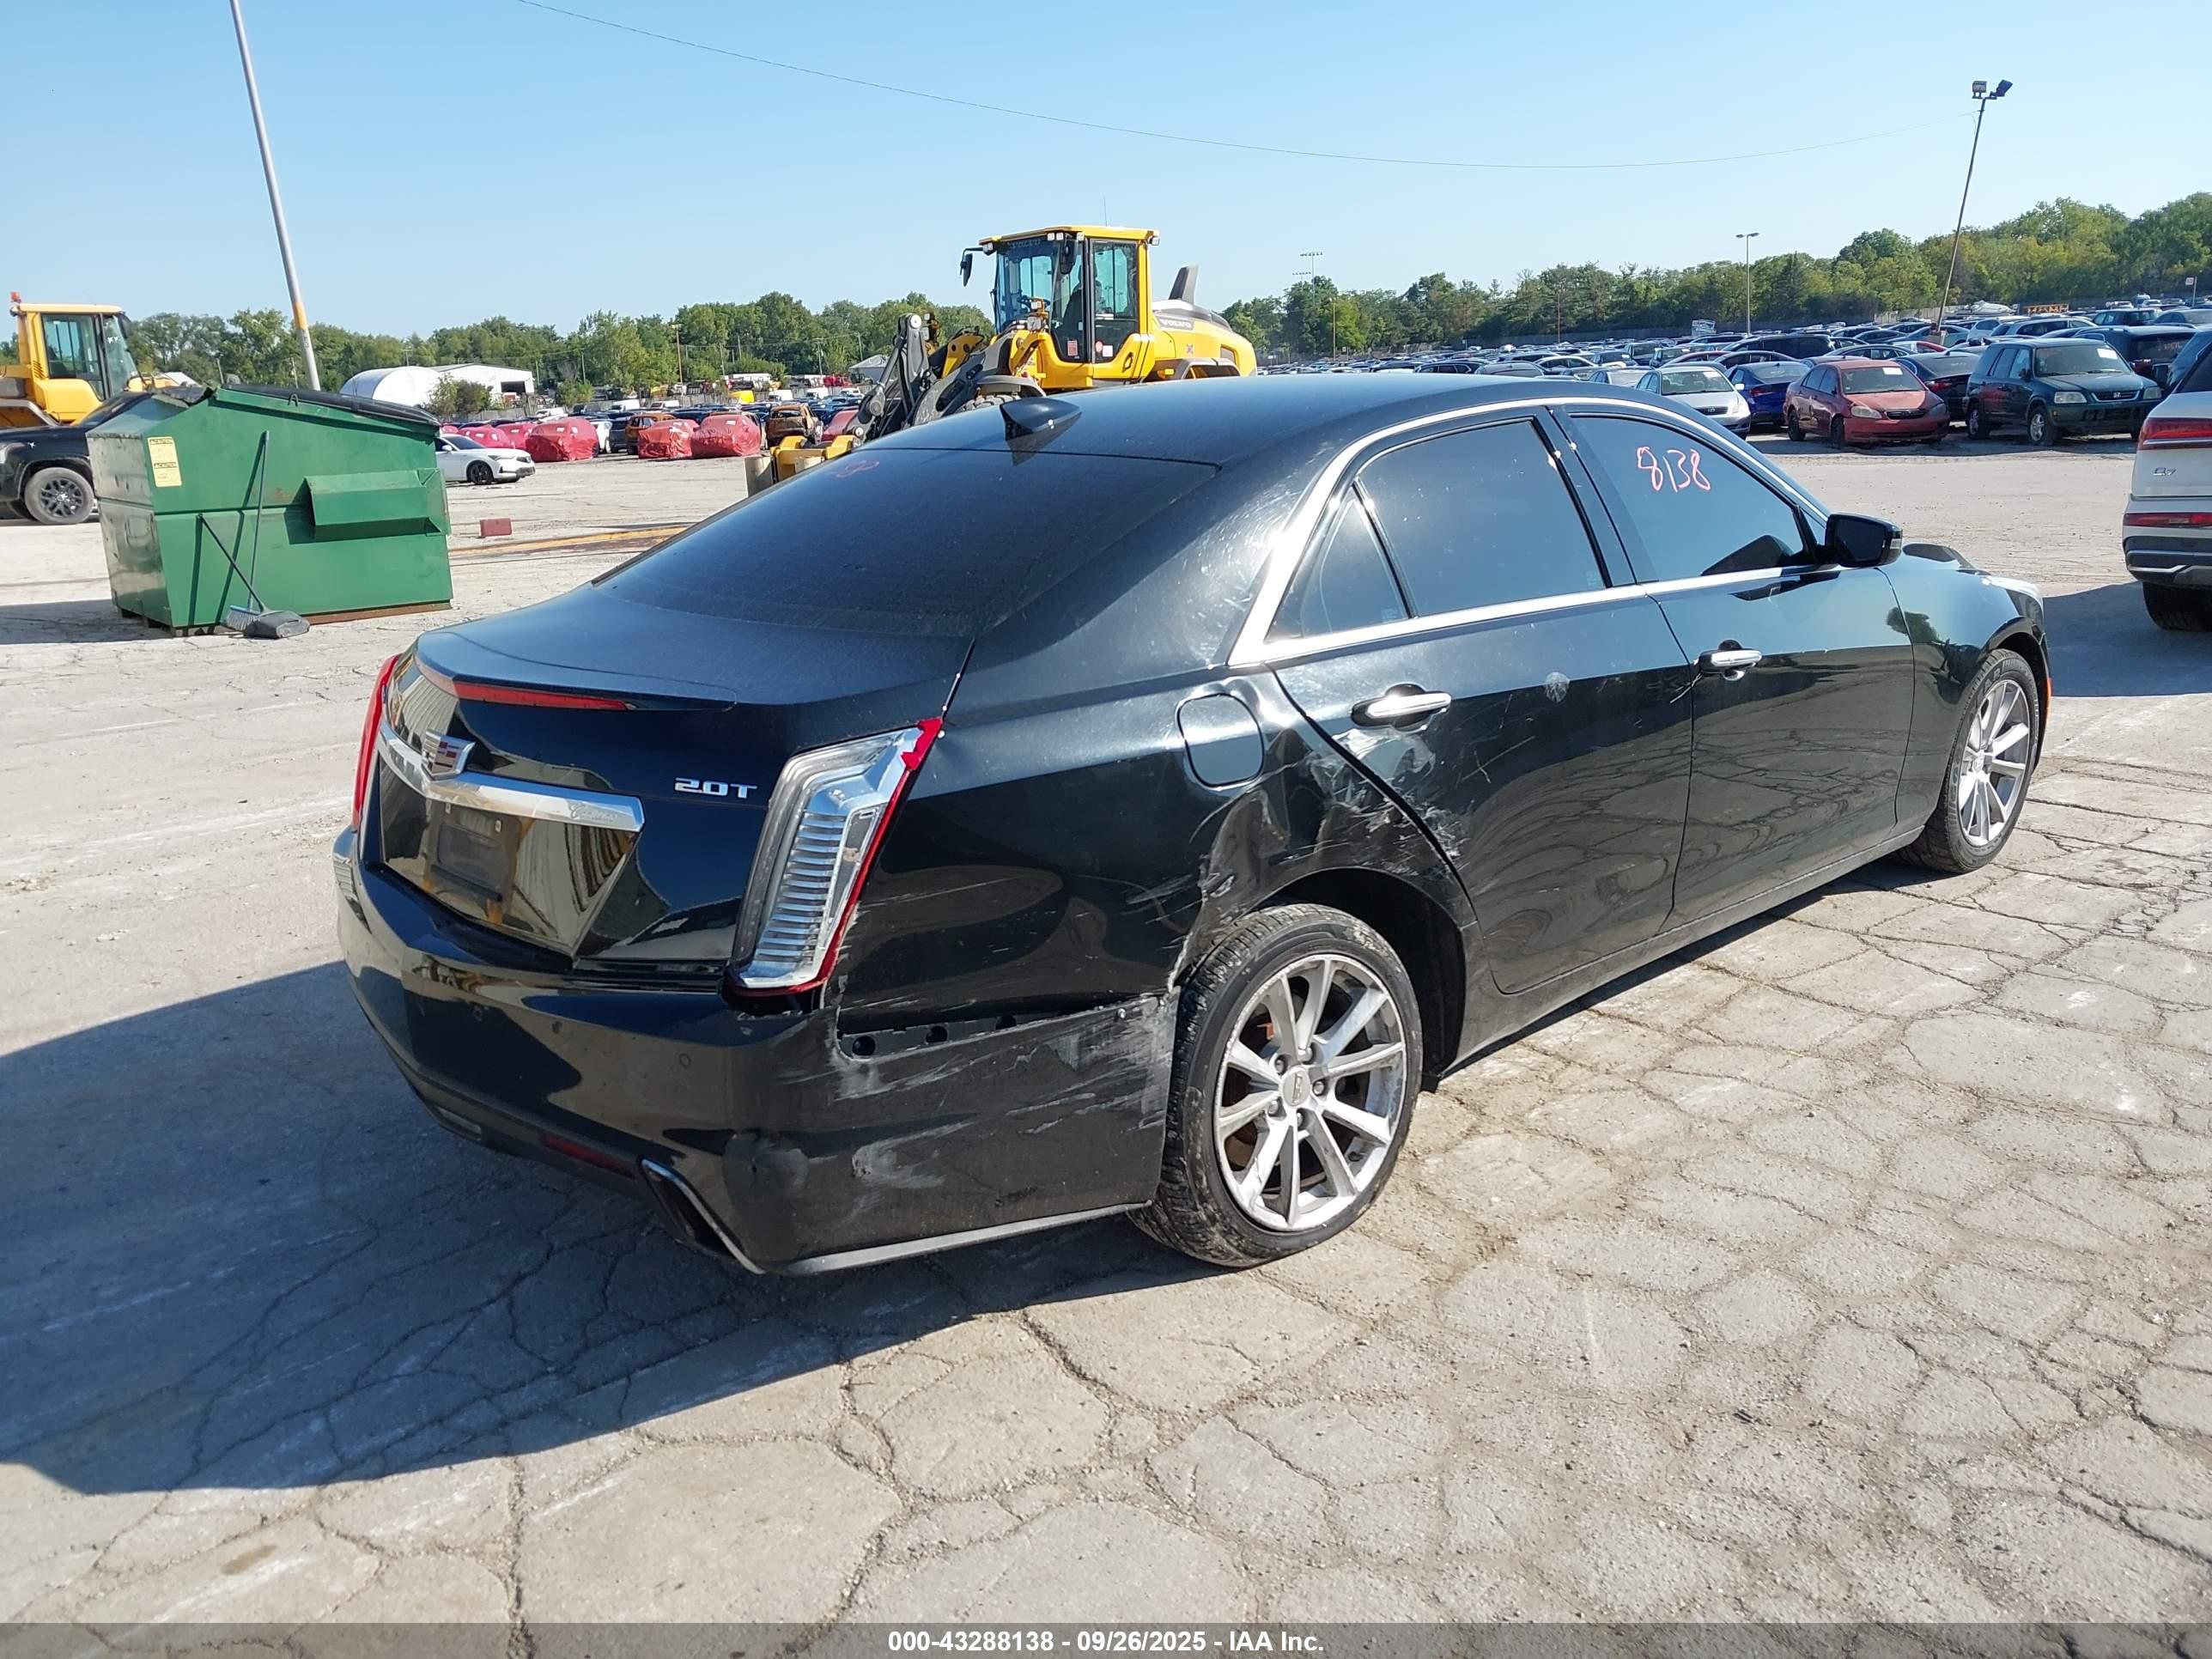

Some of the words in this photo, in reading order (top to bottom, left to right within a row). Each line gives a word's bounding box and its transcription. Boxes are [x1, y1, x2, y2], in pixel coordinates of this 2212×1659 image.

[1159, 318, 1193, 329] VOLVO
[1637, 446, 1711, 493] 8138
[2154, 466, 2177, 477] Q7
